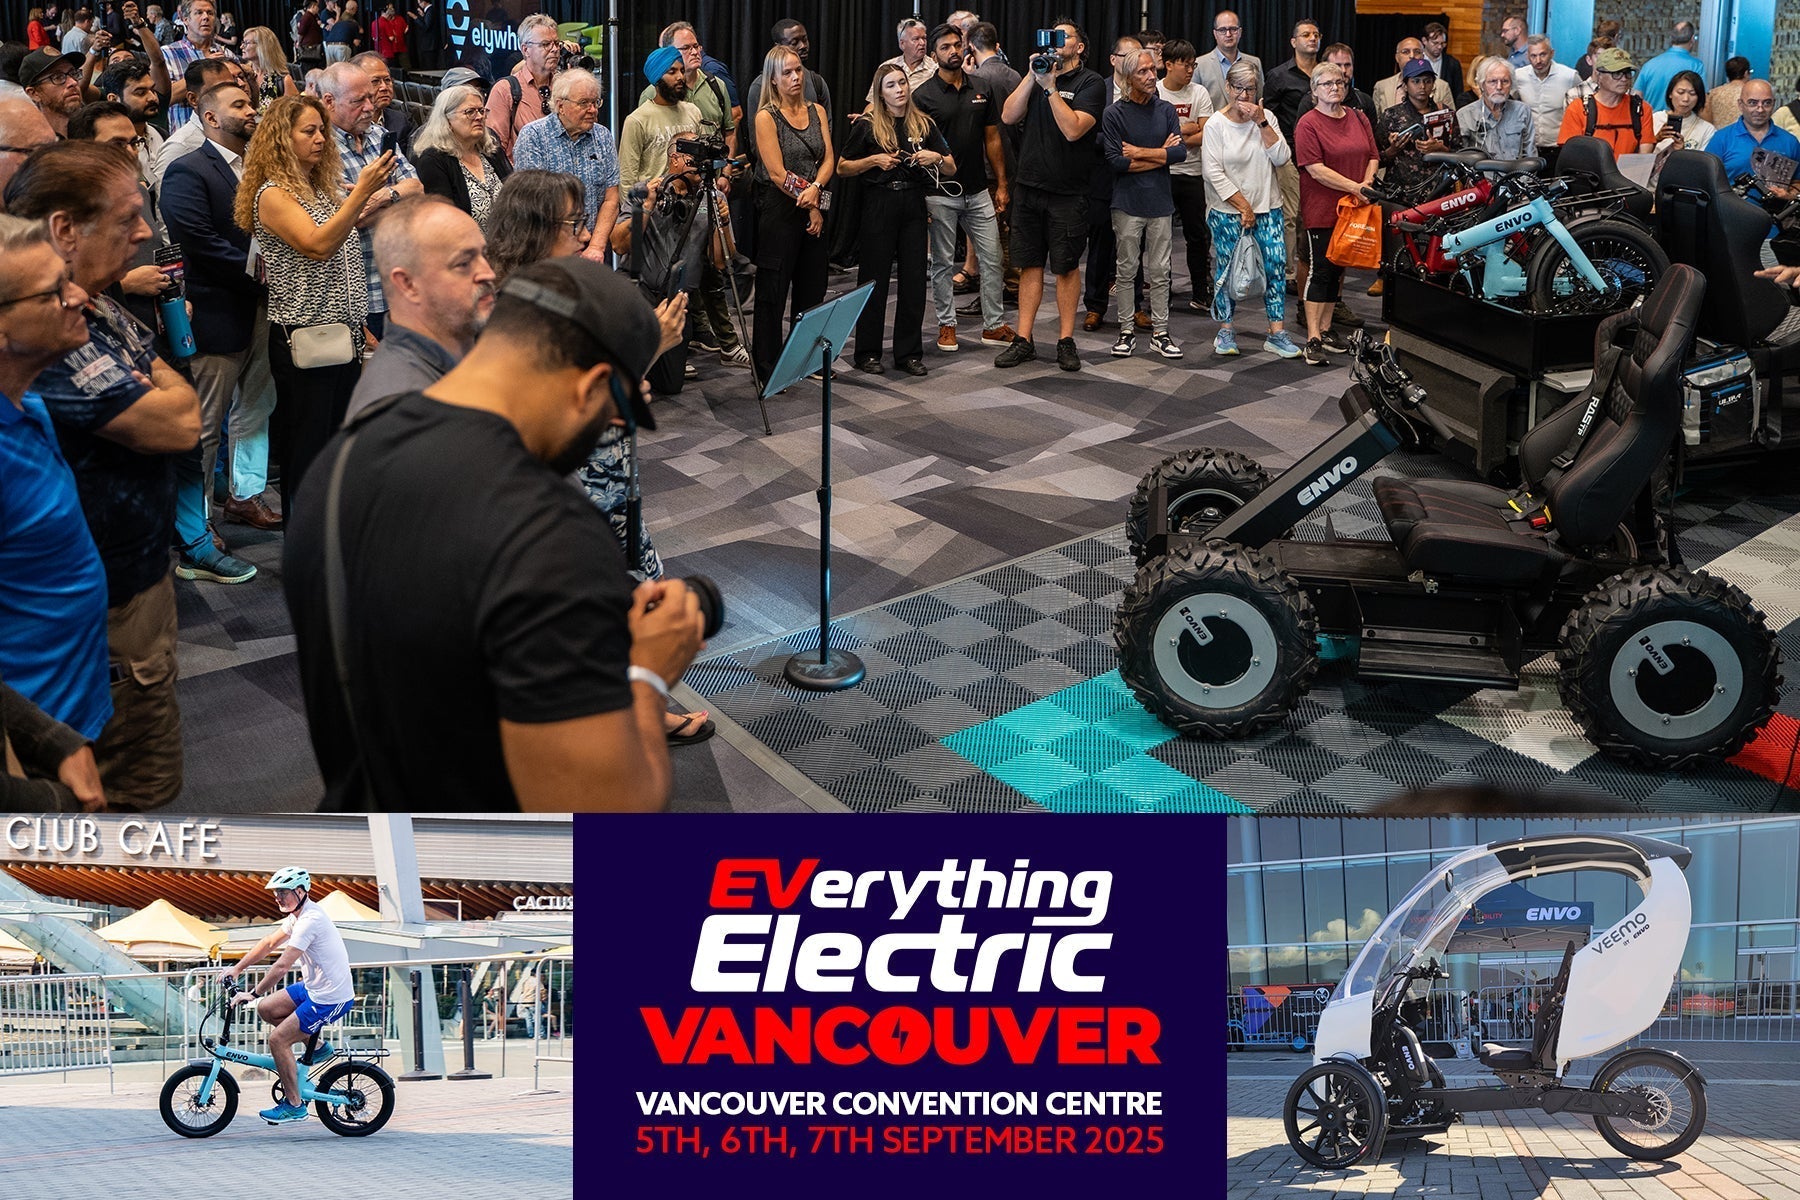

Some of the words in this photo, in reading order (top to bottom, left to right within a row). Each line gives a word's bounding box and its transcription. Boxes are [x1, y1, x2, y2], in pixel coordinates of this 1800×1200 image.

[1440, 192, 1477, 211] ENVO
[1495, 212, 1533, 233] ENVO
[1297, 456, 1358, 506] ENVO
[1185, 615, 1208, 640] ENVO
[1645, 645, 1668, 670] ENVO
[6, 816, 99, 852] CLUB
[119, 820, 218, 858] CAFE
[1526, 906, 1582, 921] ENVO
[1592, 912, 1647, 954] VEEMO
[1633, 924, 1650, 939] ENVO
[225, 1051, 249, 1061] ENVO
[1402, 1046, 1415, 1070] ENVO
